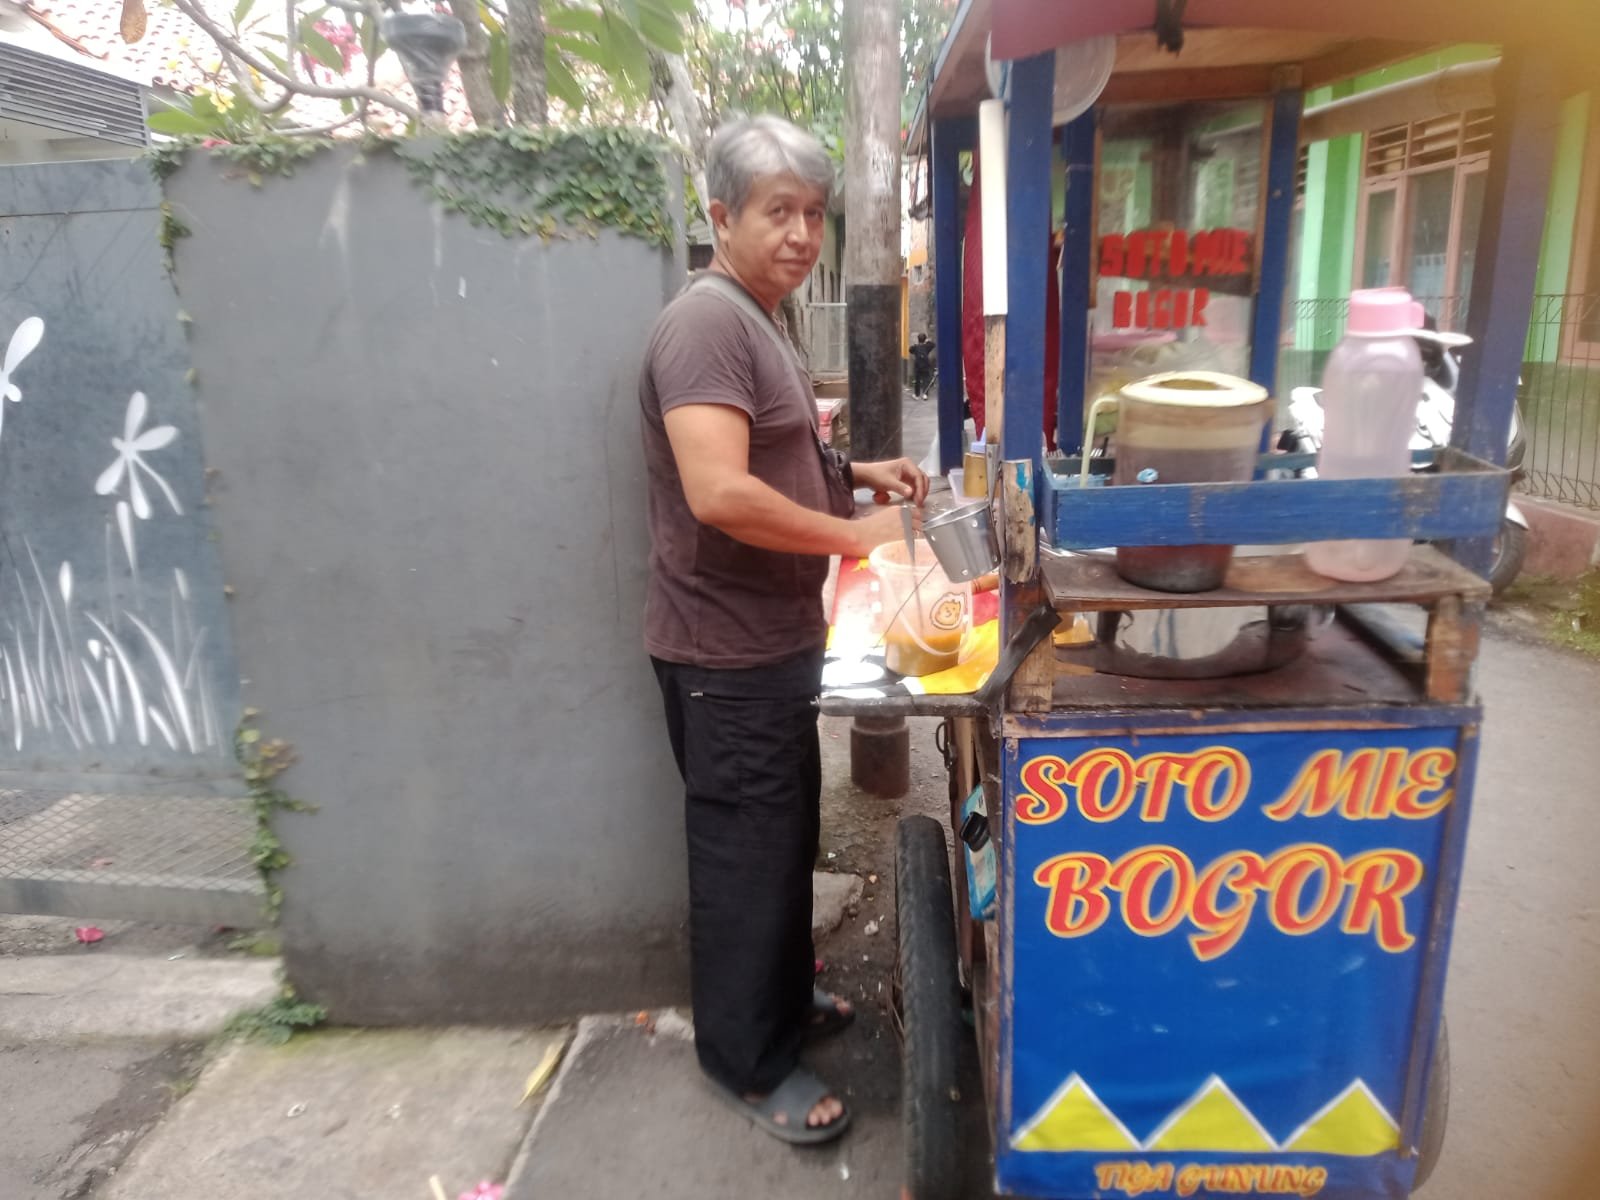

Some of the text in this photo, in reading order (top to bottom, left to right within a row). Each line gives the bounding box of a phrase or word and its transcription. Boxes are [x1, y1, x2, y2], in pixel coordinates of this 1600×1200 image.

[1014, 746, 1457, 824] SOTO MIE
[1033, 842, 1424, 961] BOGOR
[1094, 1160, 1328, 1197] TIGA GUNUNG
